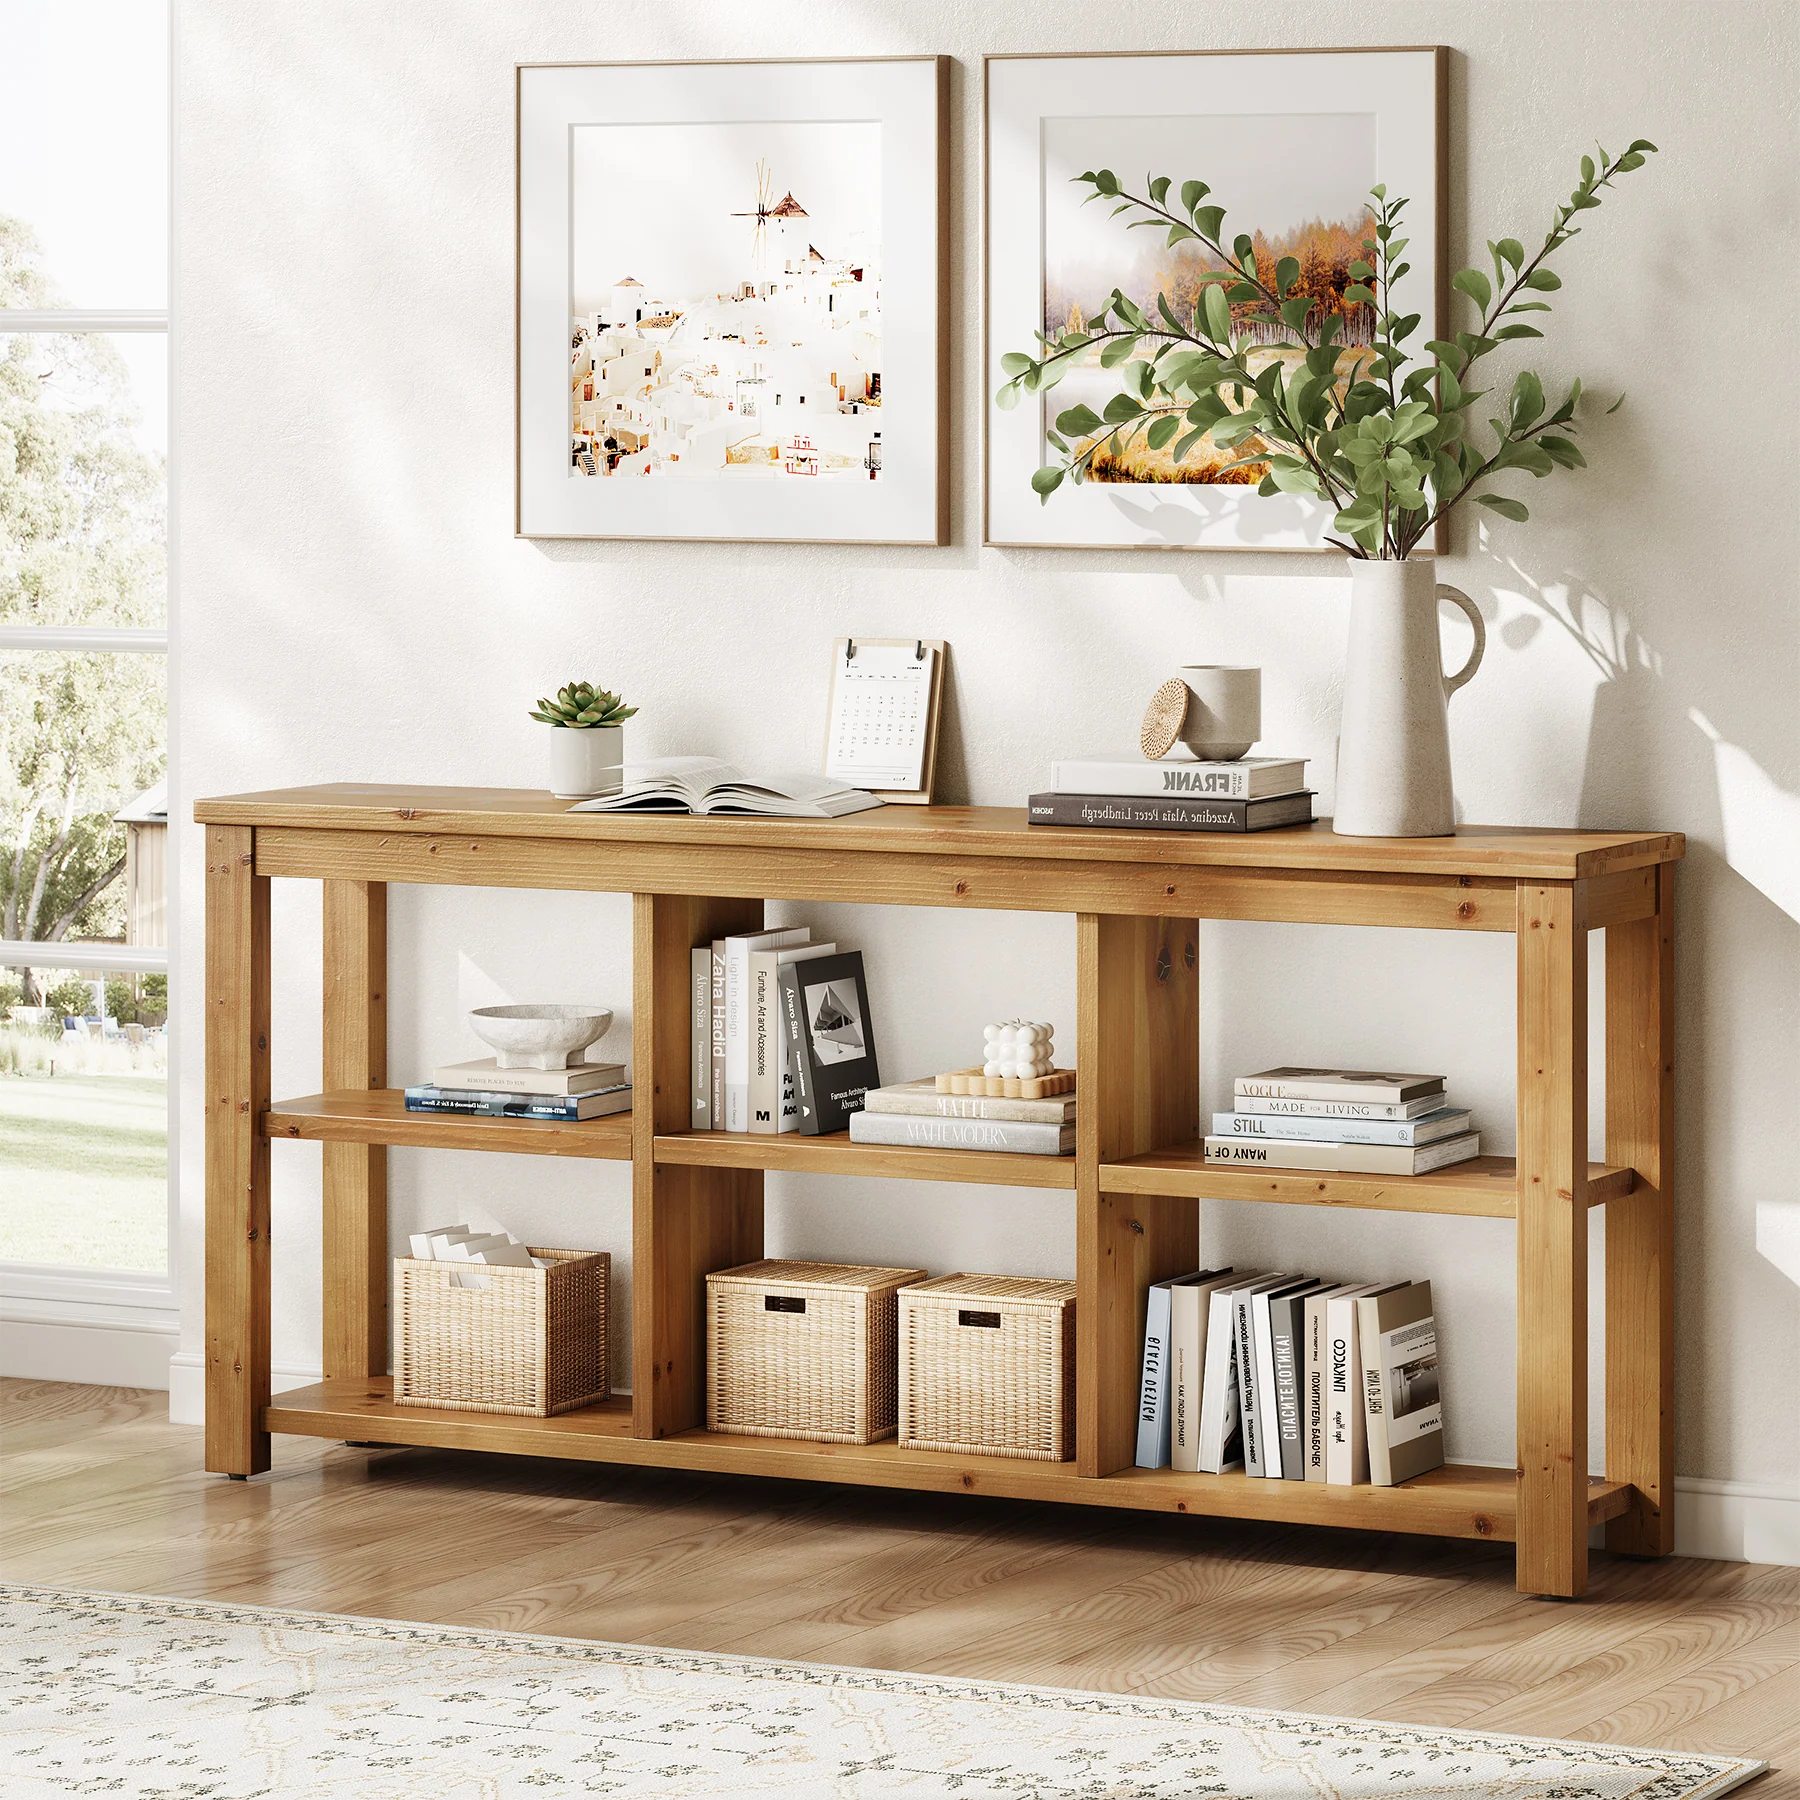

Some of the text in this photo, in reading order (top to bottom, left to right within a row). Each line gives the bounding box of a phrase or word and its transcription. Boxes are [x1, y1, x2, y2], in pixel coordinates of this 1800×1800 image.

[697, 973, 707, 1028] Álvaro Siza
[713, 953, 725, 1057] Zaha Hadid
[729, 957, 739, 1037] Light in design
[786, 987, 795, 1018] Álvaro
[757, 971, 767, 1076] Furniture, Art and Accessories
[831, 1091, 848, 1100] Famous
[1243, 1083, 1286, 1098] VOGUE
[841, 1099, 858, 1110] Álvaro
[936, 1098, 988, 1118] MATTE
[1269, 1102, 1305, 1112] MADE
[1326, 1105, 1370, 1115] LIVING
[756, 1111, 770, 1121] M
[1234, 1119, 1266, 1133] STILL
[907, 1123, 1008, 1145] MATTE MODERN
[1215, 1147, 1230, 1158] OF
[1233, 1148, 1266, 1160] MANY
[1239, 1304, 1253, 1412] Метод управления проектами
[1276, 1335, 1298, 1440] СПАСИТЕ КОТИКА!
[1312, 1372, 1320, 1467] ПОХИТИТЕЛЬ БАБОЧЕК
